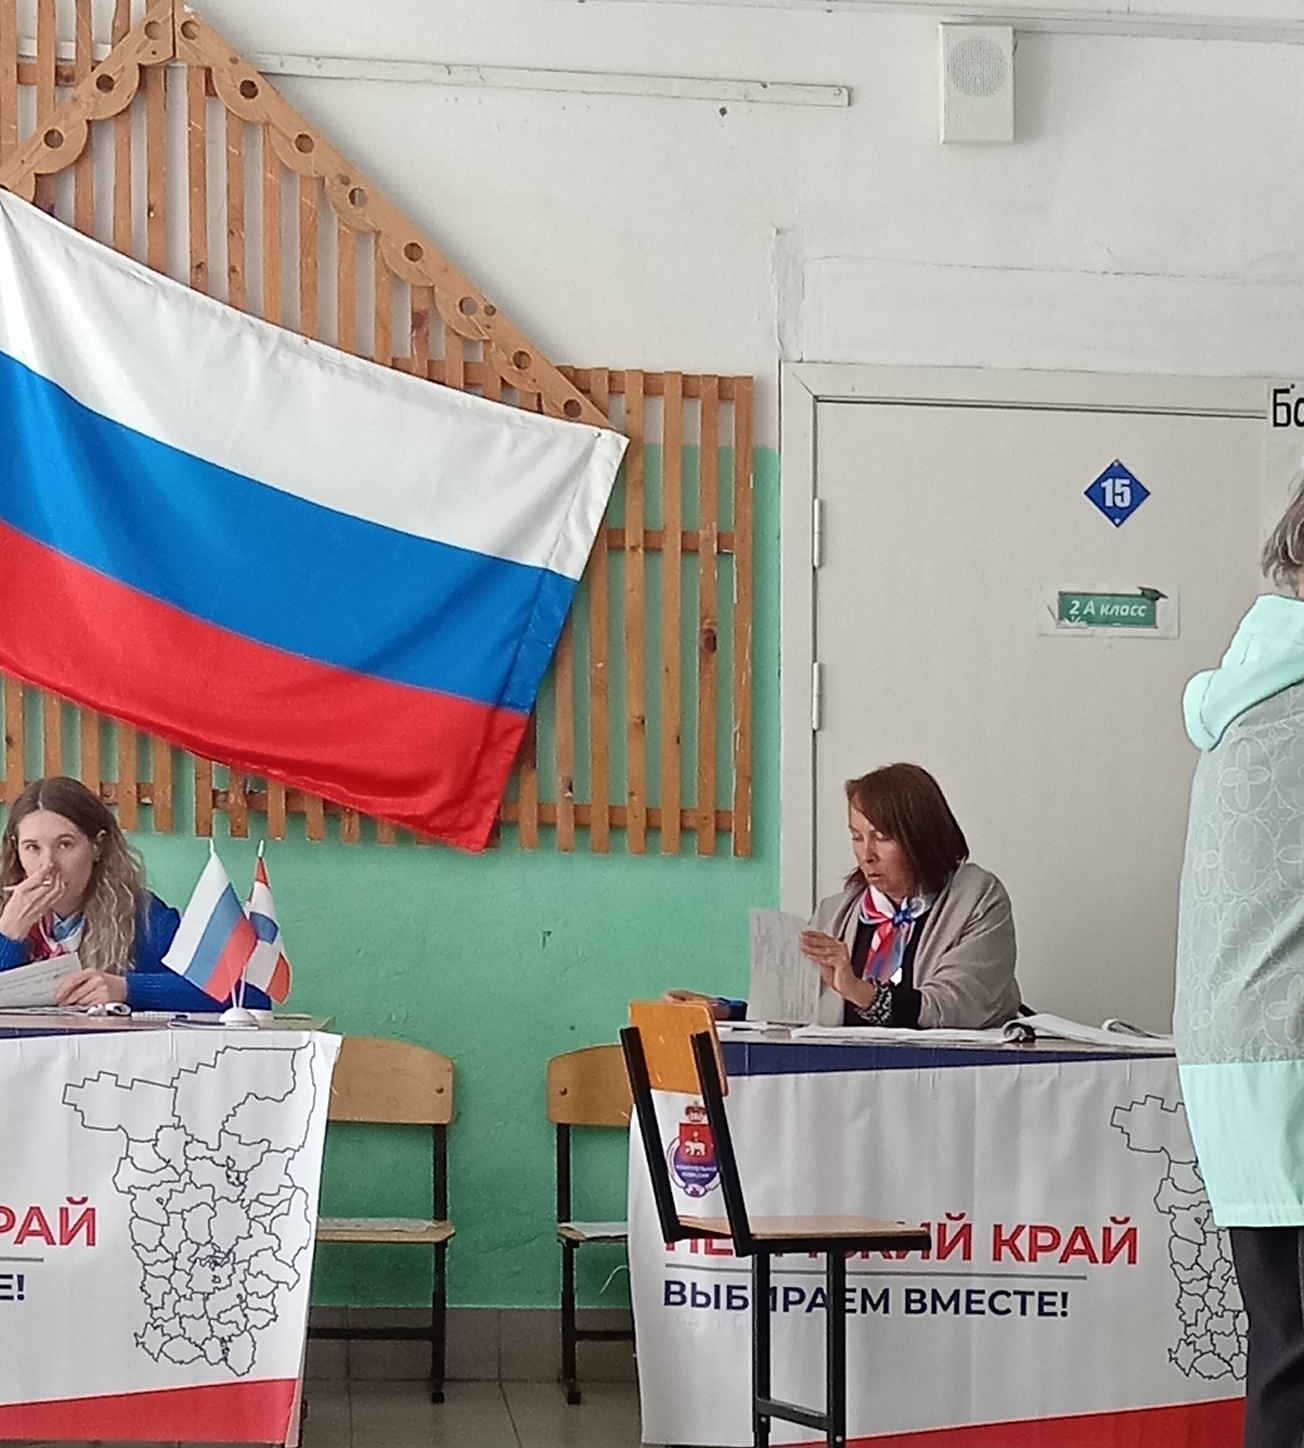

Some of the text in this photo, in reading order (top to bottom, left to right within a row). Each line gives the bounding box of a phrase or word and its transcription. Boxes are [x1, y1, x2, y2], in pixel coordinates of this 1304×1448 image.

[1101, 478, 1131, 508] 15
[1069, 600, 1147, 617] 2 А класс
[0, 1197, 96, 1246] РАЙ
[992, 1216, 1138, 1266] КРАЙ
[904, 1287, 1069, 1319] ВМЕСТЕ!
